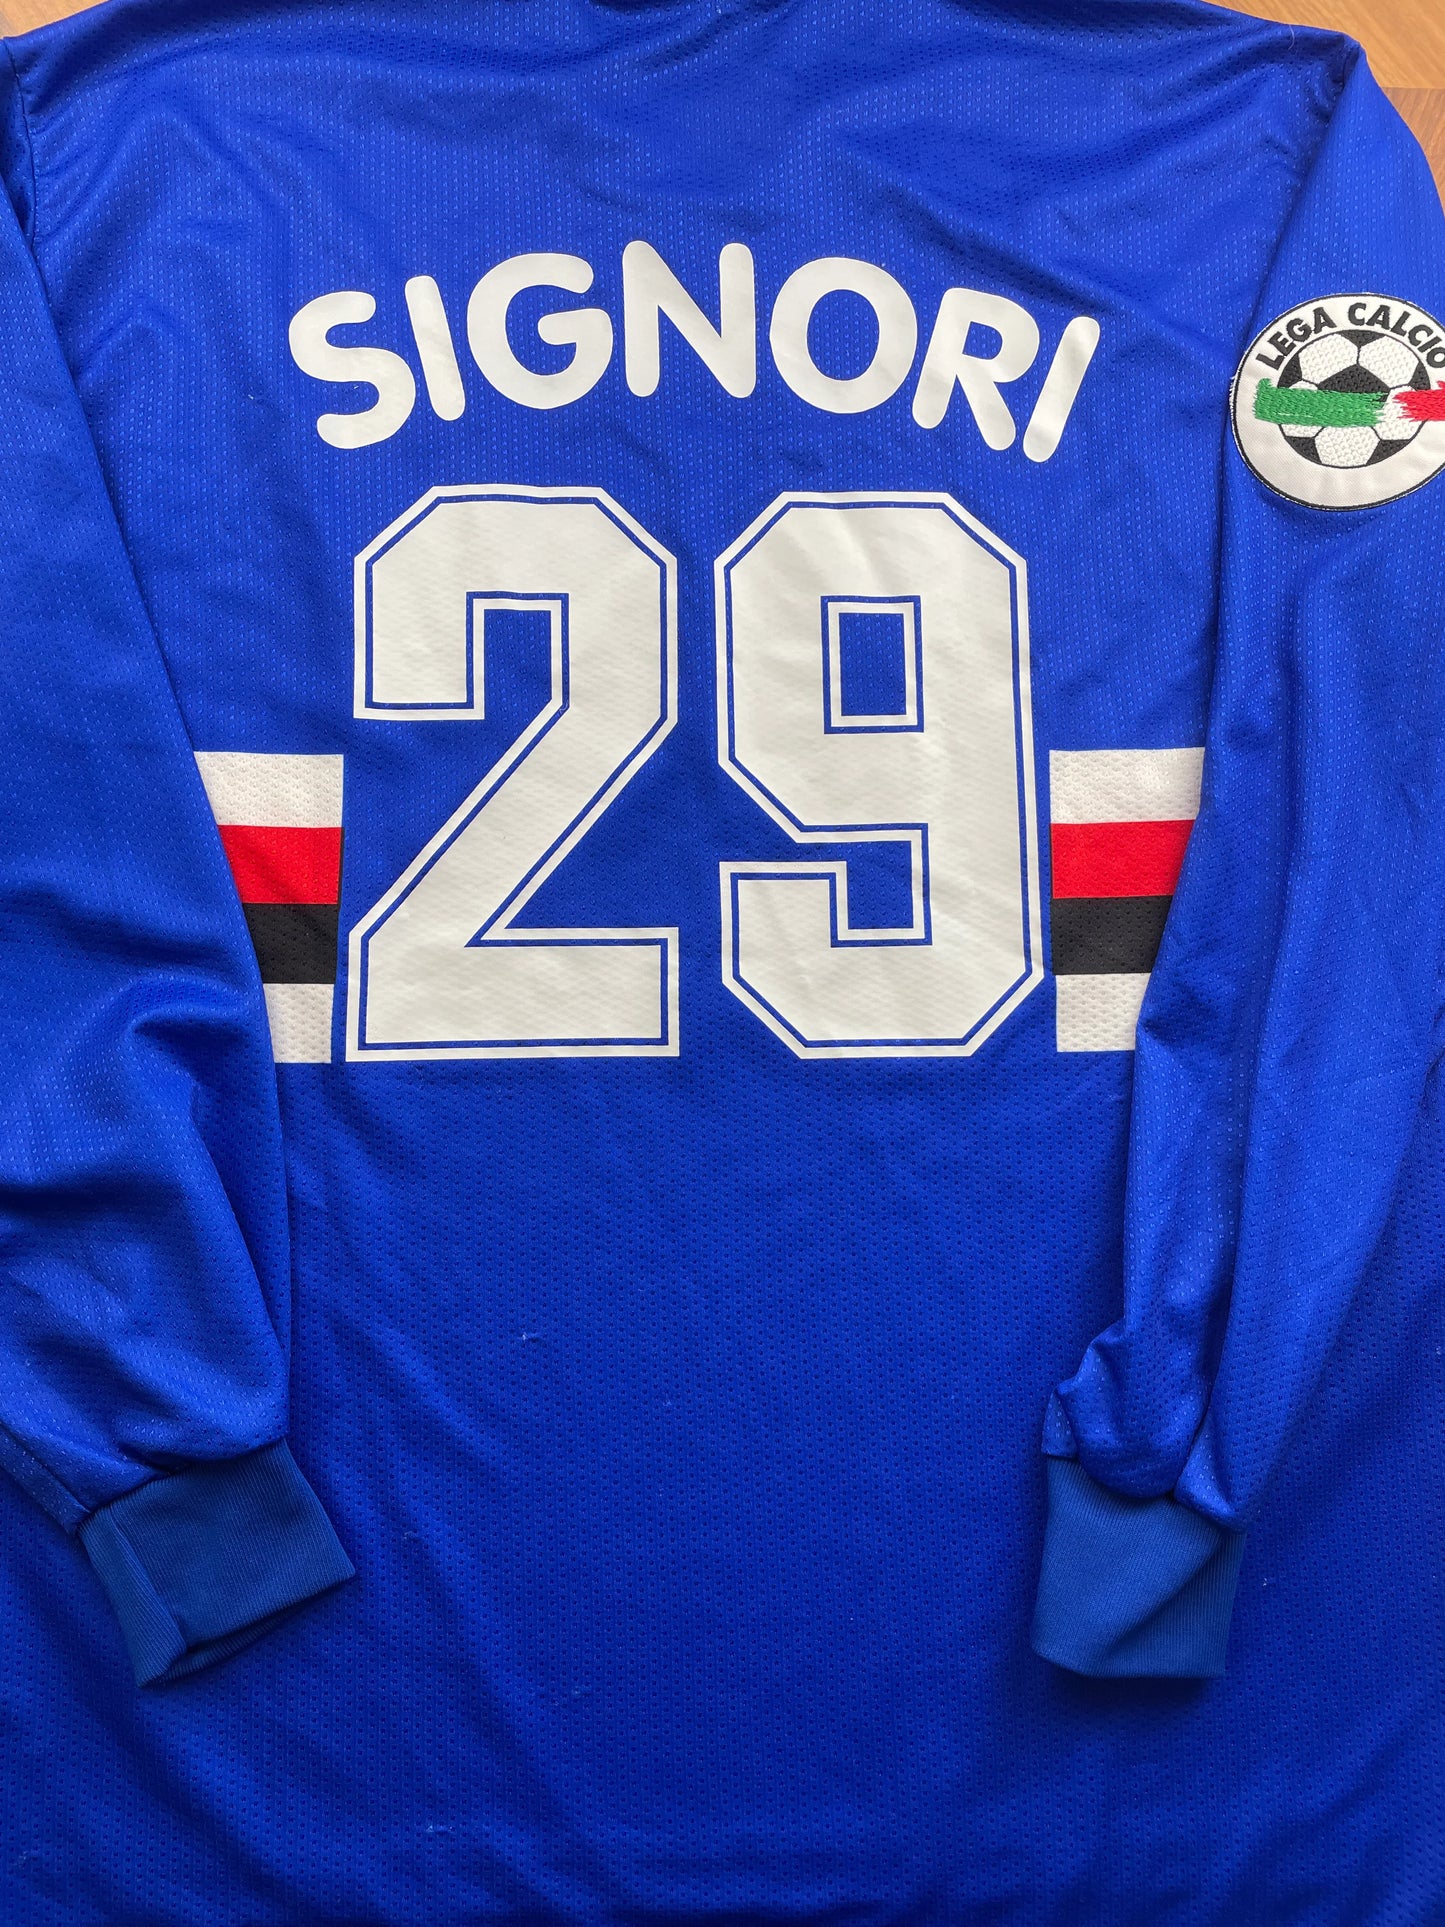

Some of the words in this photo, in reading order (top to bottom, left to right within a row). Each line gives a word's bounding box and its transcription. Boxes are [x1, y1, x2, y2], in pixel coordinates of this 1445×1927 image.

[288, 240, 1101, 463] SIGNORI
[1256, 306, 1337, 371] LEGA
[1347, 302, 1445, 369] CALCIO
[345, 484, 1045, 1060] 29
